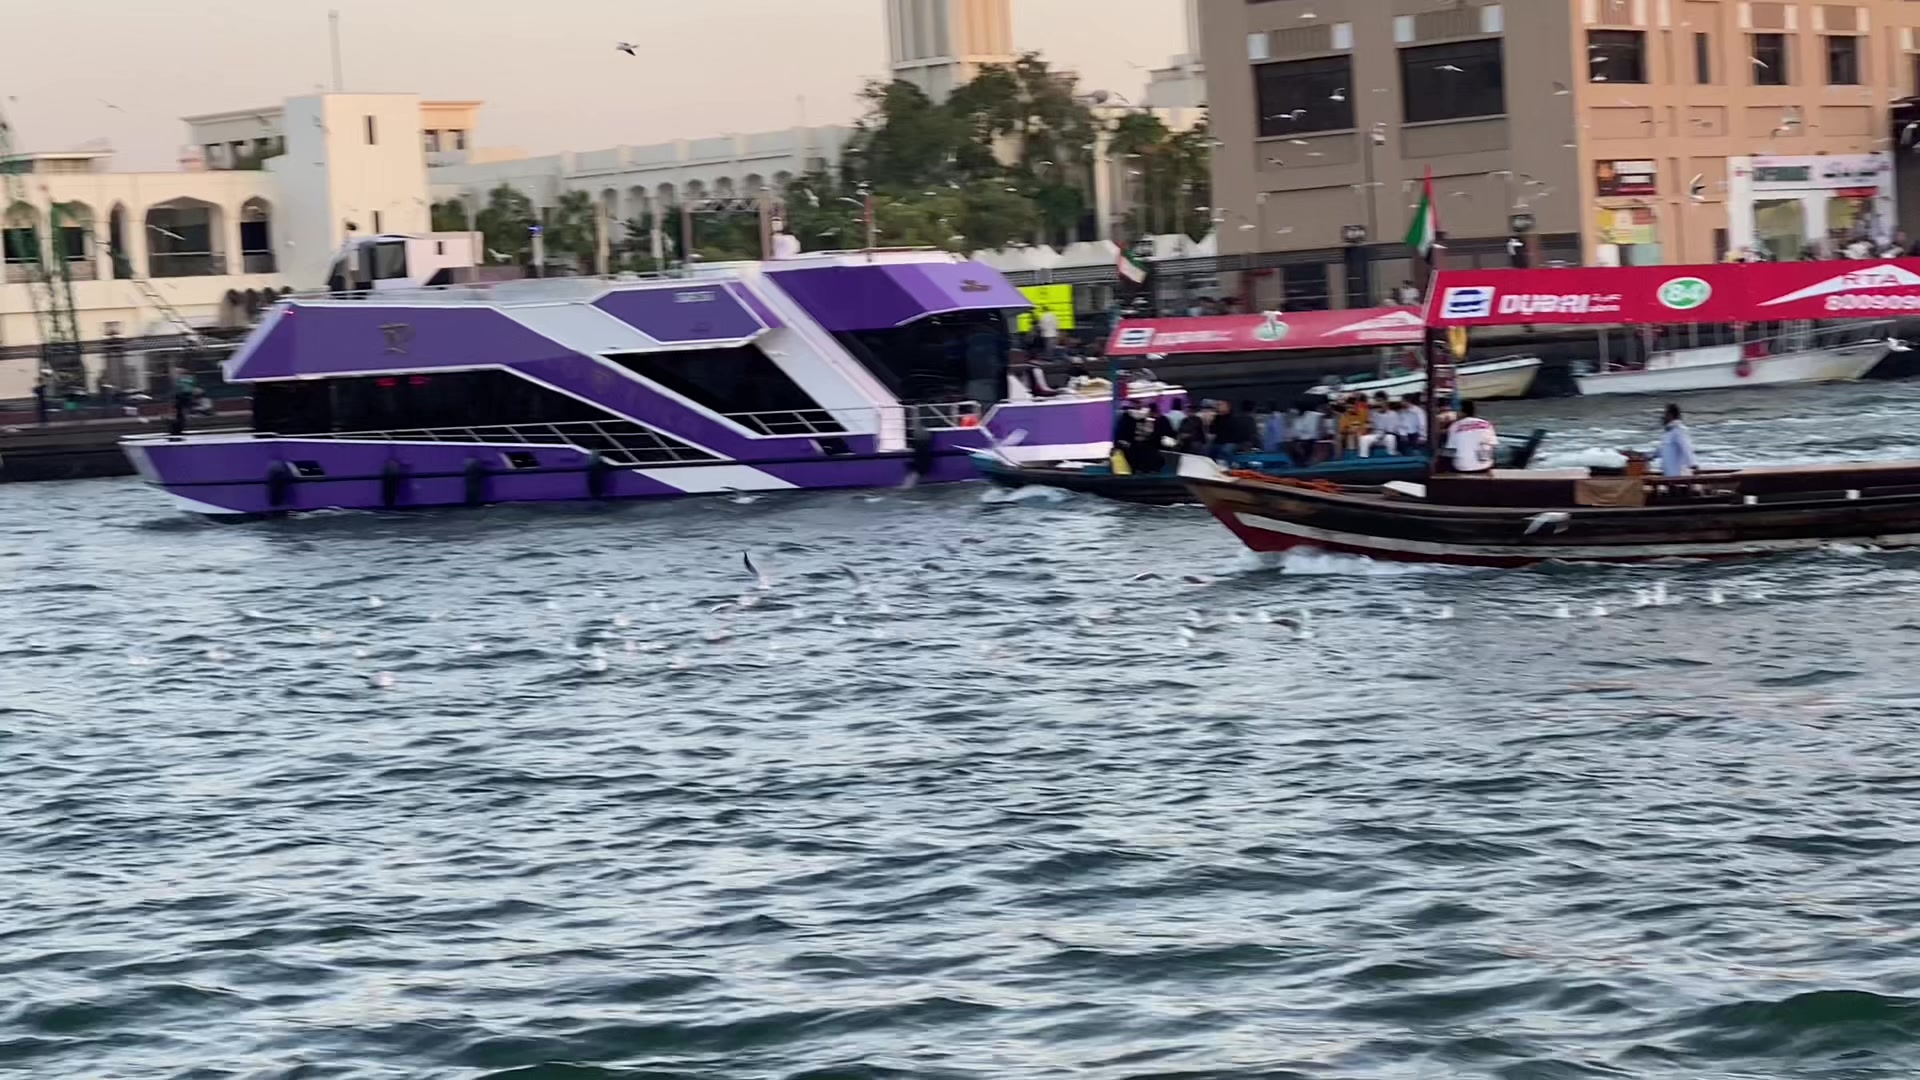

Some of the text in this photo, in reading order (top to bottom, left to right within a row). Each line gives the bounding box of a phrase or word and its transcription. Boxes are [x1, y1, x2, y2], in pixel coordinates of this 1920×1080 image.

[1842, 273, 1900, 288] RTA
[1499, 293, 1591, 315] DUBAI
[1824, 294, 1920, 310] 800909
